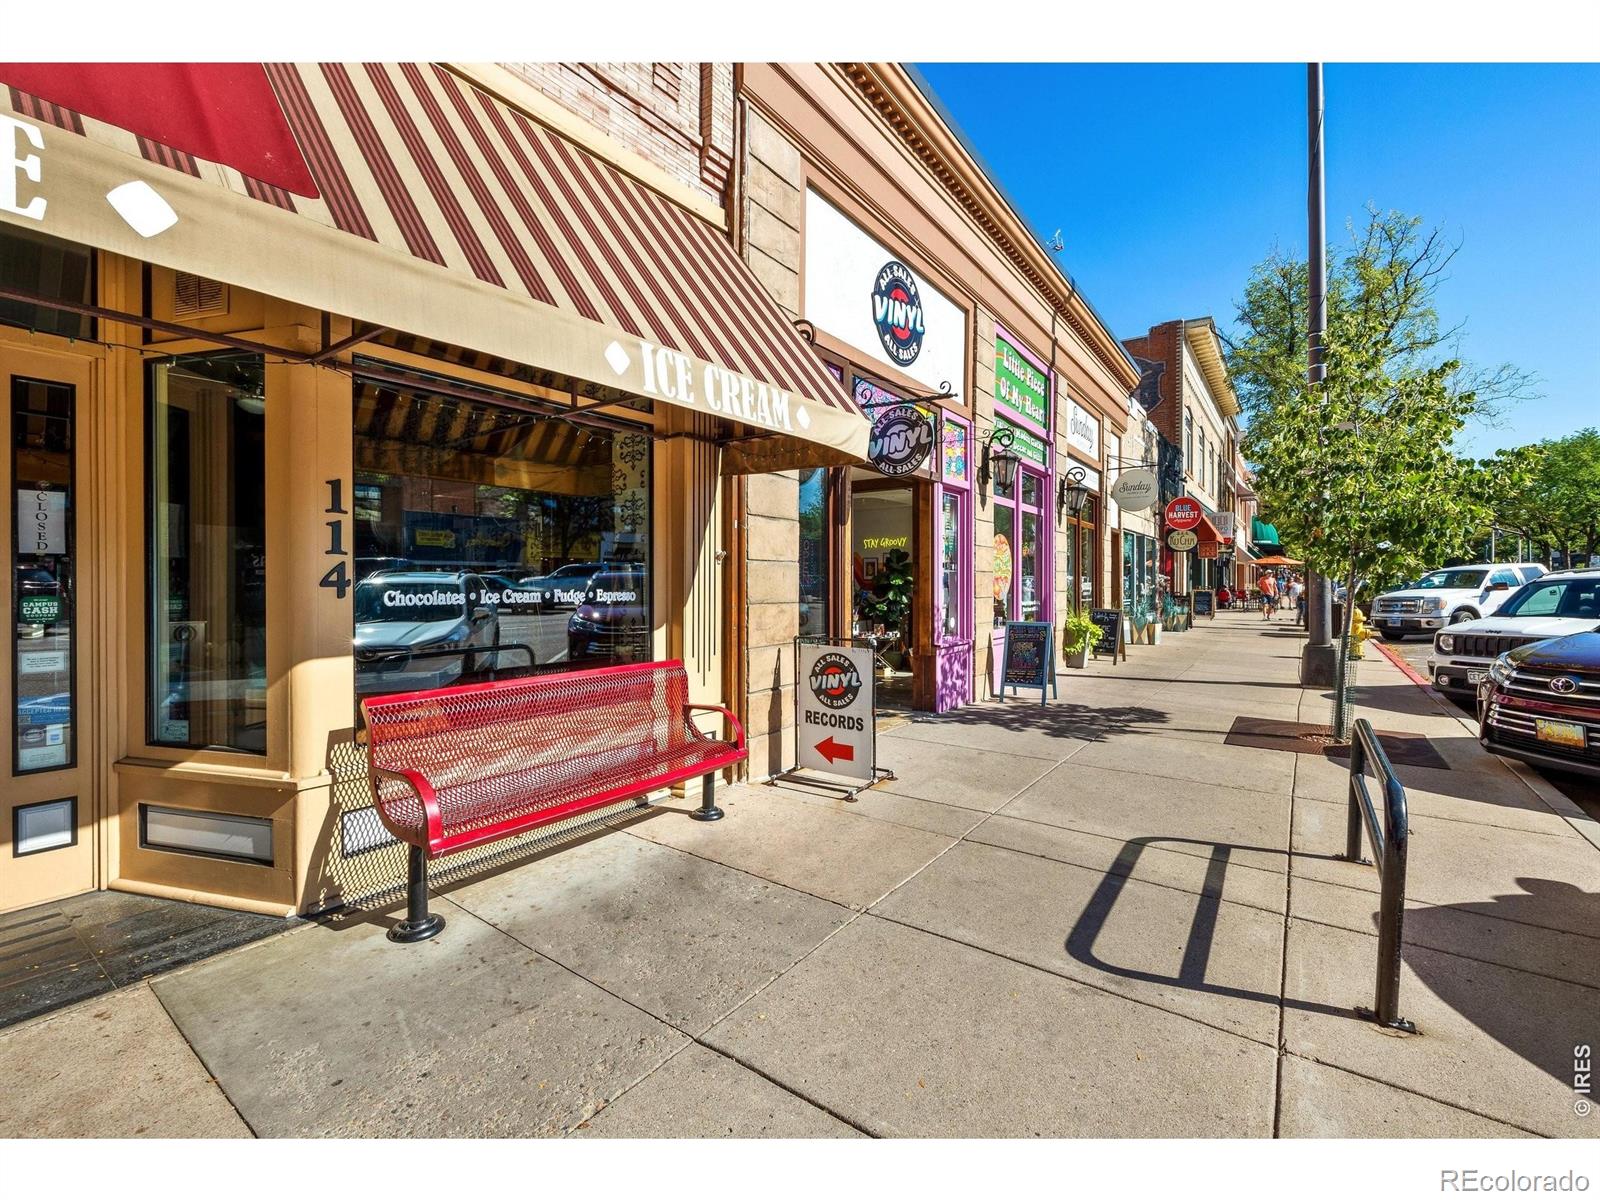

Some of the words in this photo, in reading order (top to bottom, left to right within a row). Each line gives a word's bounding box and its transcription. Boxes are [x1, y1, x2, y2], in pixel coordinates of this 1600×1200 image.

[879, 268, 893, 291] ALL
[893, 265, 916, 295] SALES
[873, 294, 925, 334] VINYL
[884, 334, 898, 356] ALL
[898, 342, 918, 361] SALES
[1003, 347, 1025, 382] Little
[1026, 367, 1045, 396] Piece
[639, 340, 695, 404] ICE
[703, 364, 795, 432] CREAM
[1000, 377, 1010, 400] Of
[1011, 385, 1023, 413] My
[874, 417, 888, 435] ALL
[889, 408, 919, 420] SALES
[869, 424, 932, 459] VINYL
[880, 462, 894, 474] ALL
[896, 453, 922, 474] SALES
[1119, 481, 1151, 494] Sunday
[1168, 511, 1198, 519] HARVEST
[1175, 504, 1192, 512] BLUE
[36, 491, 49, 551] CLOSED
[319, 478, 352, 599] 114
[863, 538, 879, 549] STAY
[880, 537, 907, 548] GROOVY
[384, 590, 466, 607] Chocolates
[480, 589, 500, 604] Ice
[502, 589, 541, 603] Cream
[553, 589, 586, 605] Fudge
[596, 589, 636, 604] Espresso
[814, 659, 826, 672] ALL
[826, 654, 850, 667] SALES
[810, 672, 862, 690] VINYL
[819, 694, 831, 706] ALL
[832, 693, 854, 707] SALES
[805, 710, 864, 731] RECORDS
